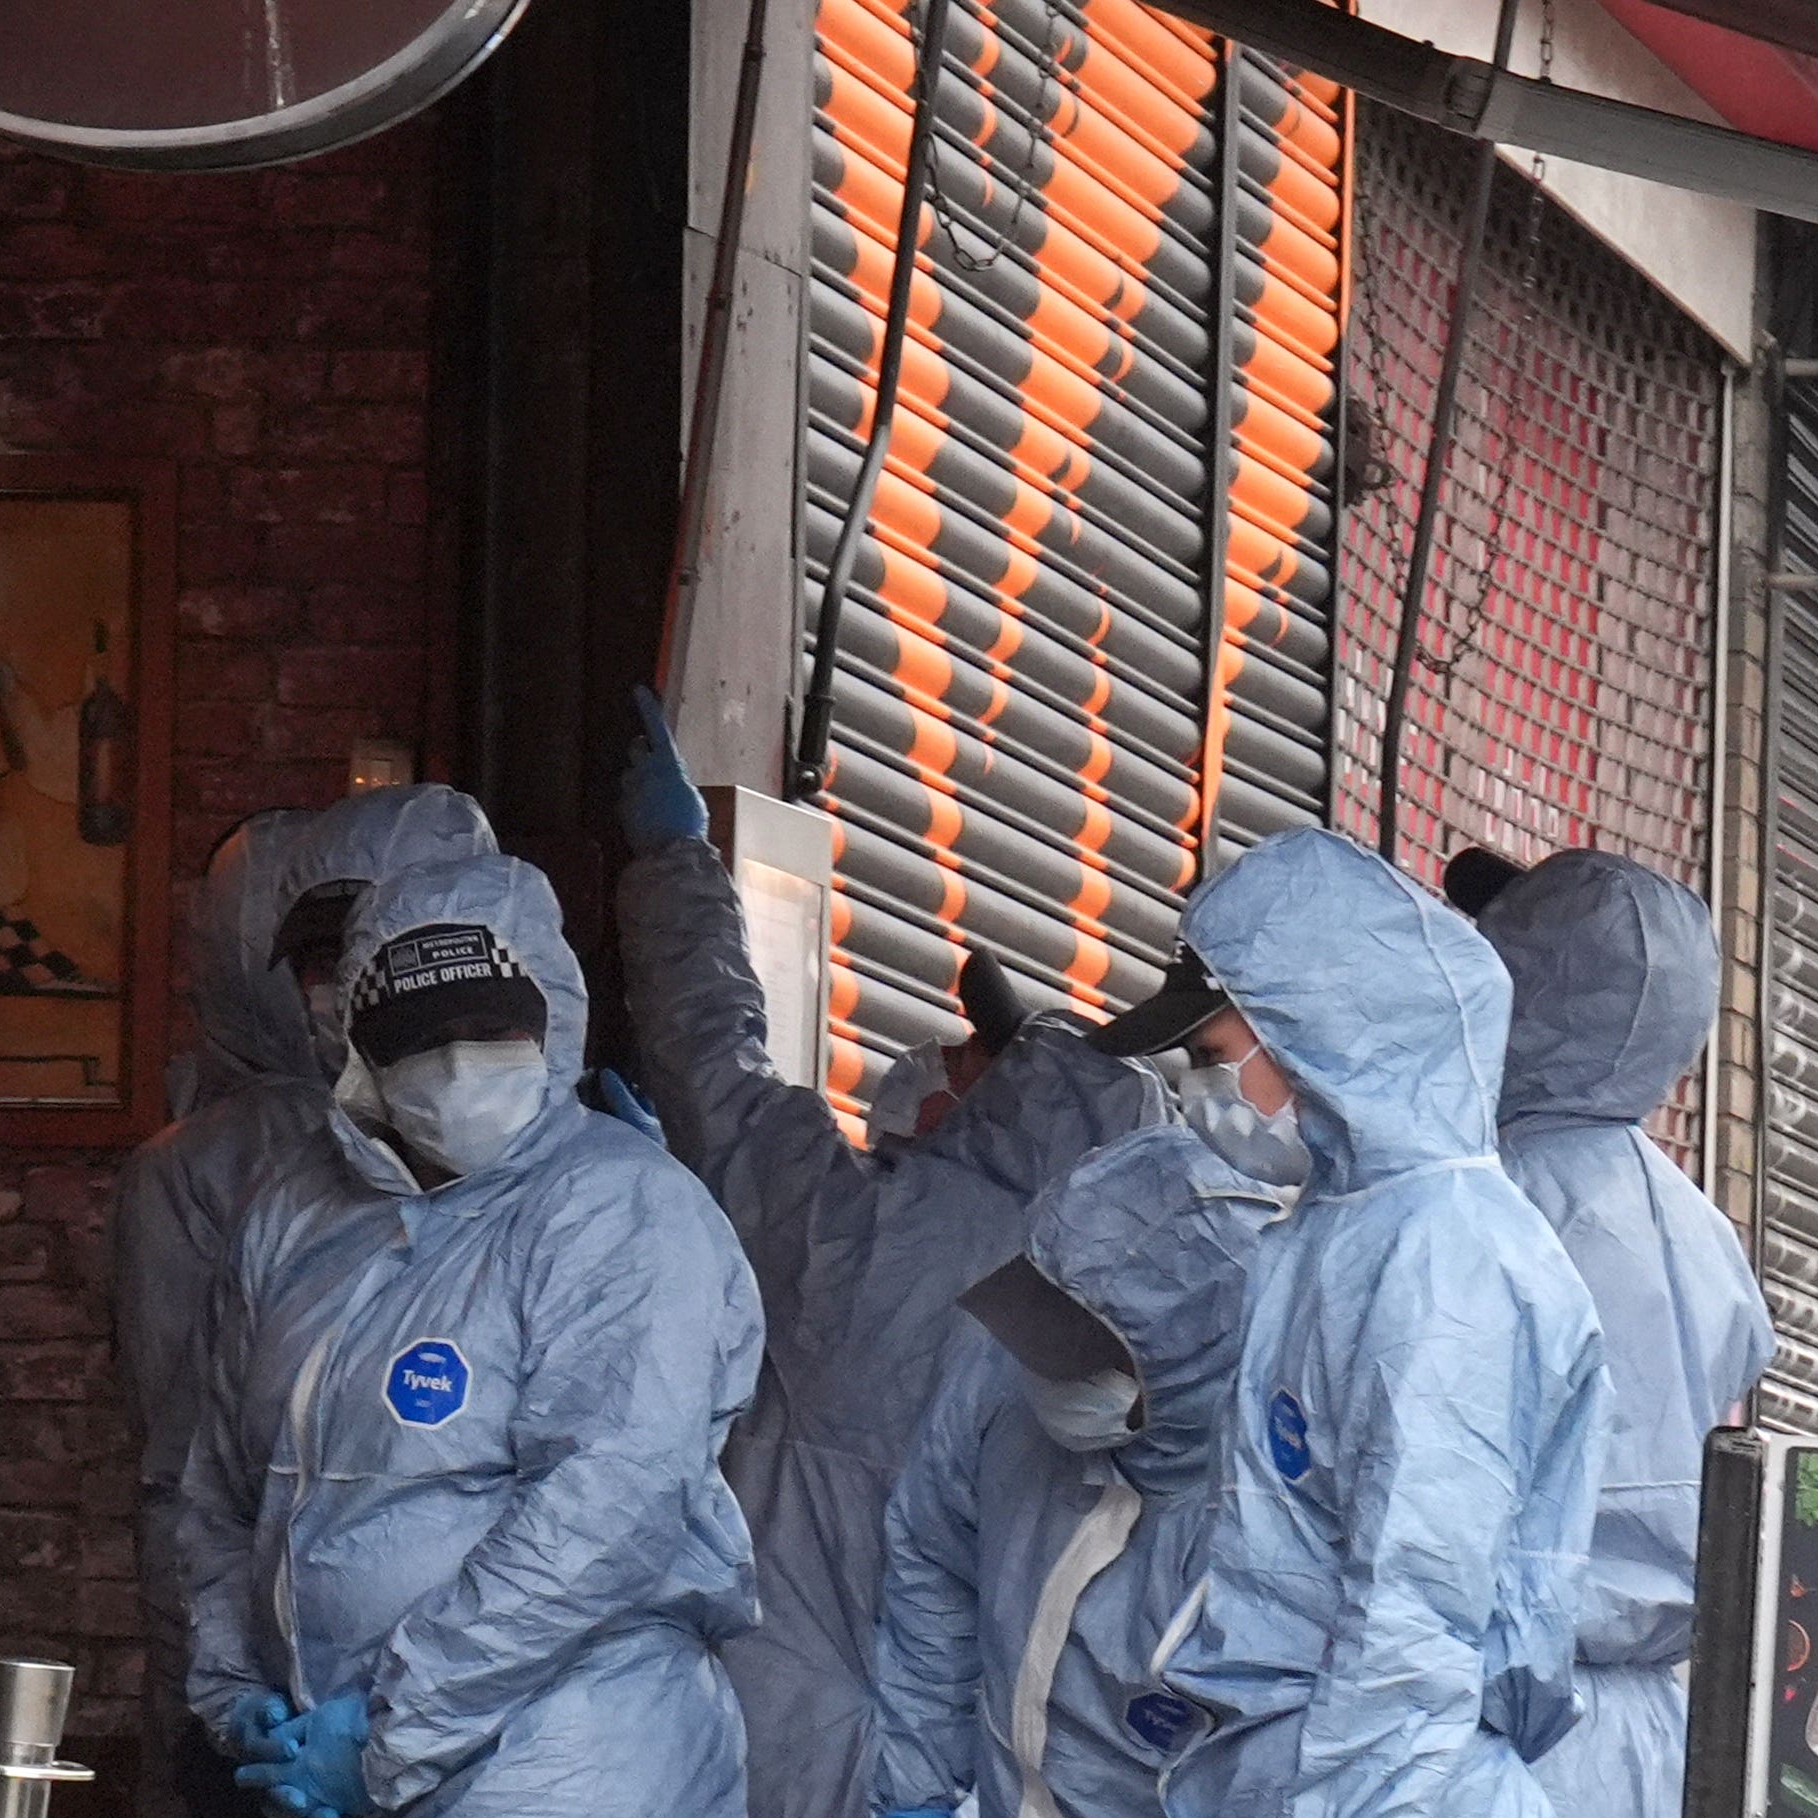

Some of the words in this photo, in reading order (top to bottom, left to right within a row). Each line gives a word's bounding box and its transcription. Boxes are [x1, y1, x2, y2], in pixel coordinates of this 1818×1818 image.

[432, 946, 475, 960] POLICE
[393, 970, 438, 994] POLICE
[439, 962, 493, 983] OFFICER
[402, 1369, 453, 1393] Tyvek
